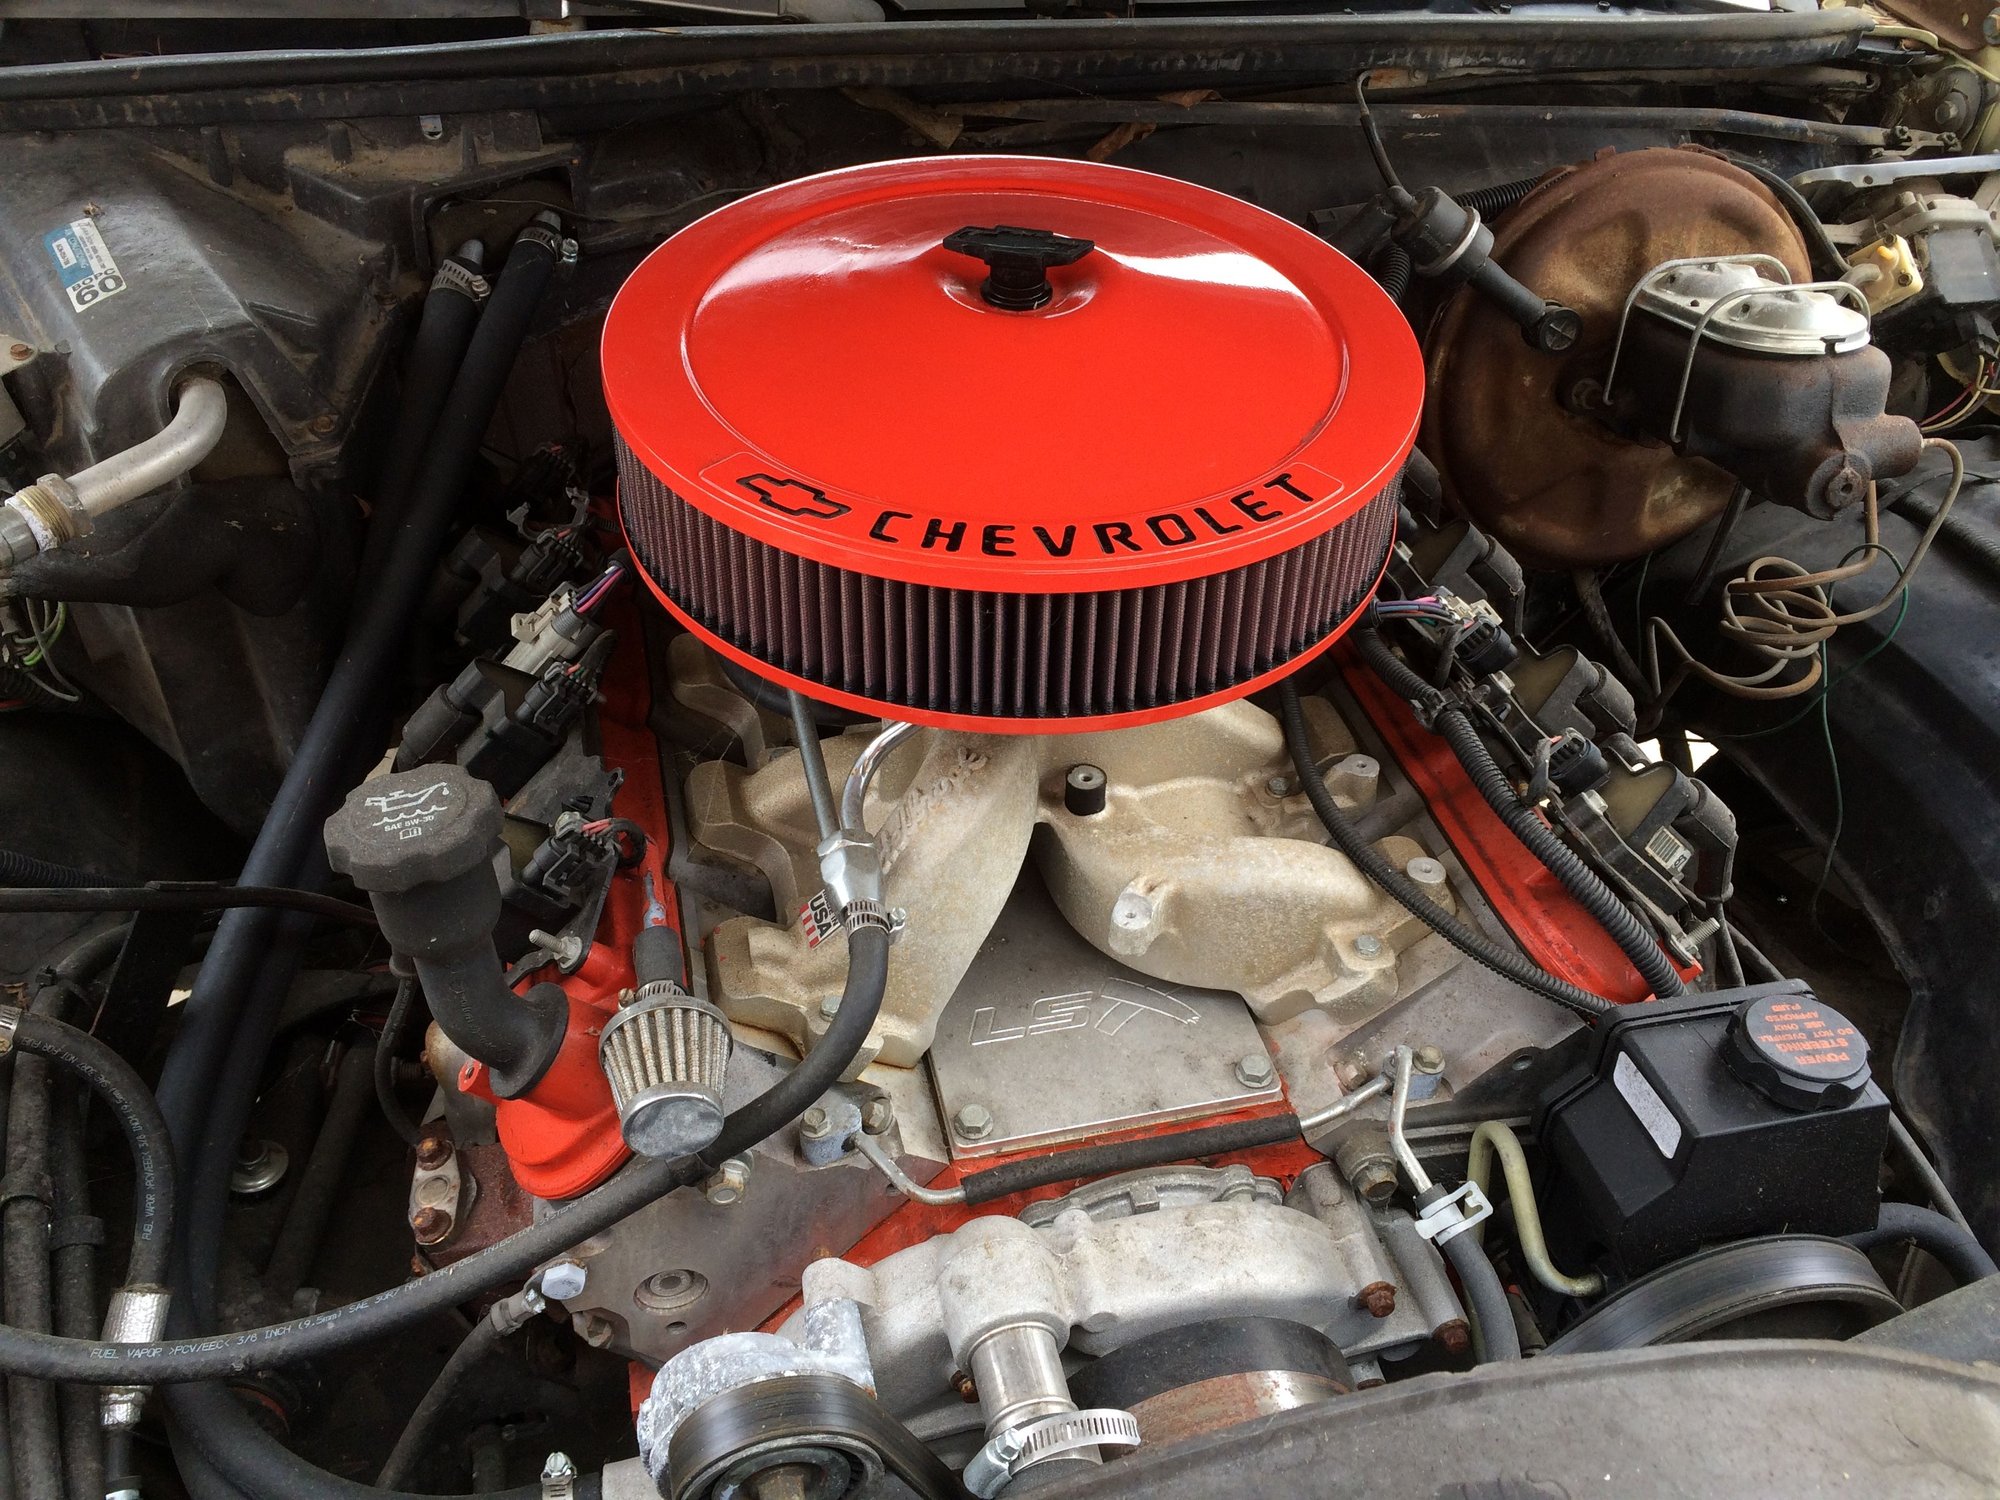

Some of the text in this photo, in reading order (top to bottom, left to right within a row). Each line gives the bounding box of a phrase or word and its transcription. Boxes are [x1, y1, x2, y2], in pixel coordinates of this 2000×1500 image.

[72, 268, 115, 292] BOPC
[75, 274, 124, 306] 60
[868, 472, 1314, 557] CHEVROLET
[384, 815, 435, 832] SAE 5W-30
[809, 894, 832, 938] USA
[1765, 1010, 1819, 1023] APPROVED
[1771, 1003, 1802, 1012] FLUID
[1757, 1027, 1855, 1042] DO NOT OVERFILL
[1774, 1020, 1826, 1031] USE ONLY
[1776, 1037, 1849, 1053] STEERING
[1794, 1052, 1850, 1065] POWER
[145, 1193, 156, 1218] VAPOR
[141, 1221, 155, 1241] FUEL
[89, 1348, 119, 1359] FUEL
[127, 1347, 163, 1359] VAPOR
[236, 1334, 258, 1346] 3/8
[264, 1325, 292, 1340] INCH
[298, 1311, 342, 1330] (9.5mm)
[348, 1301, 370, 1313] SAE
[404, 1278, 423, 1292] NOT
[428, 1268, 449, 1282] FOR
